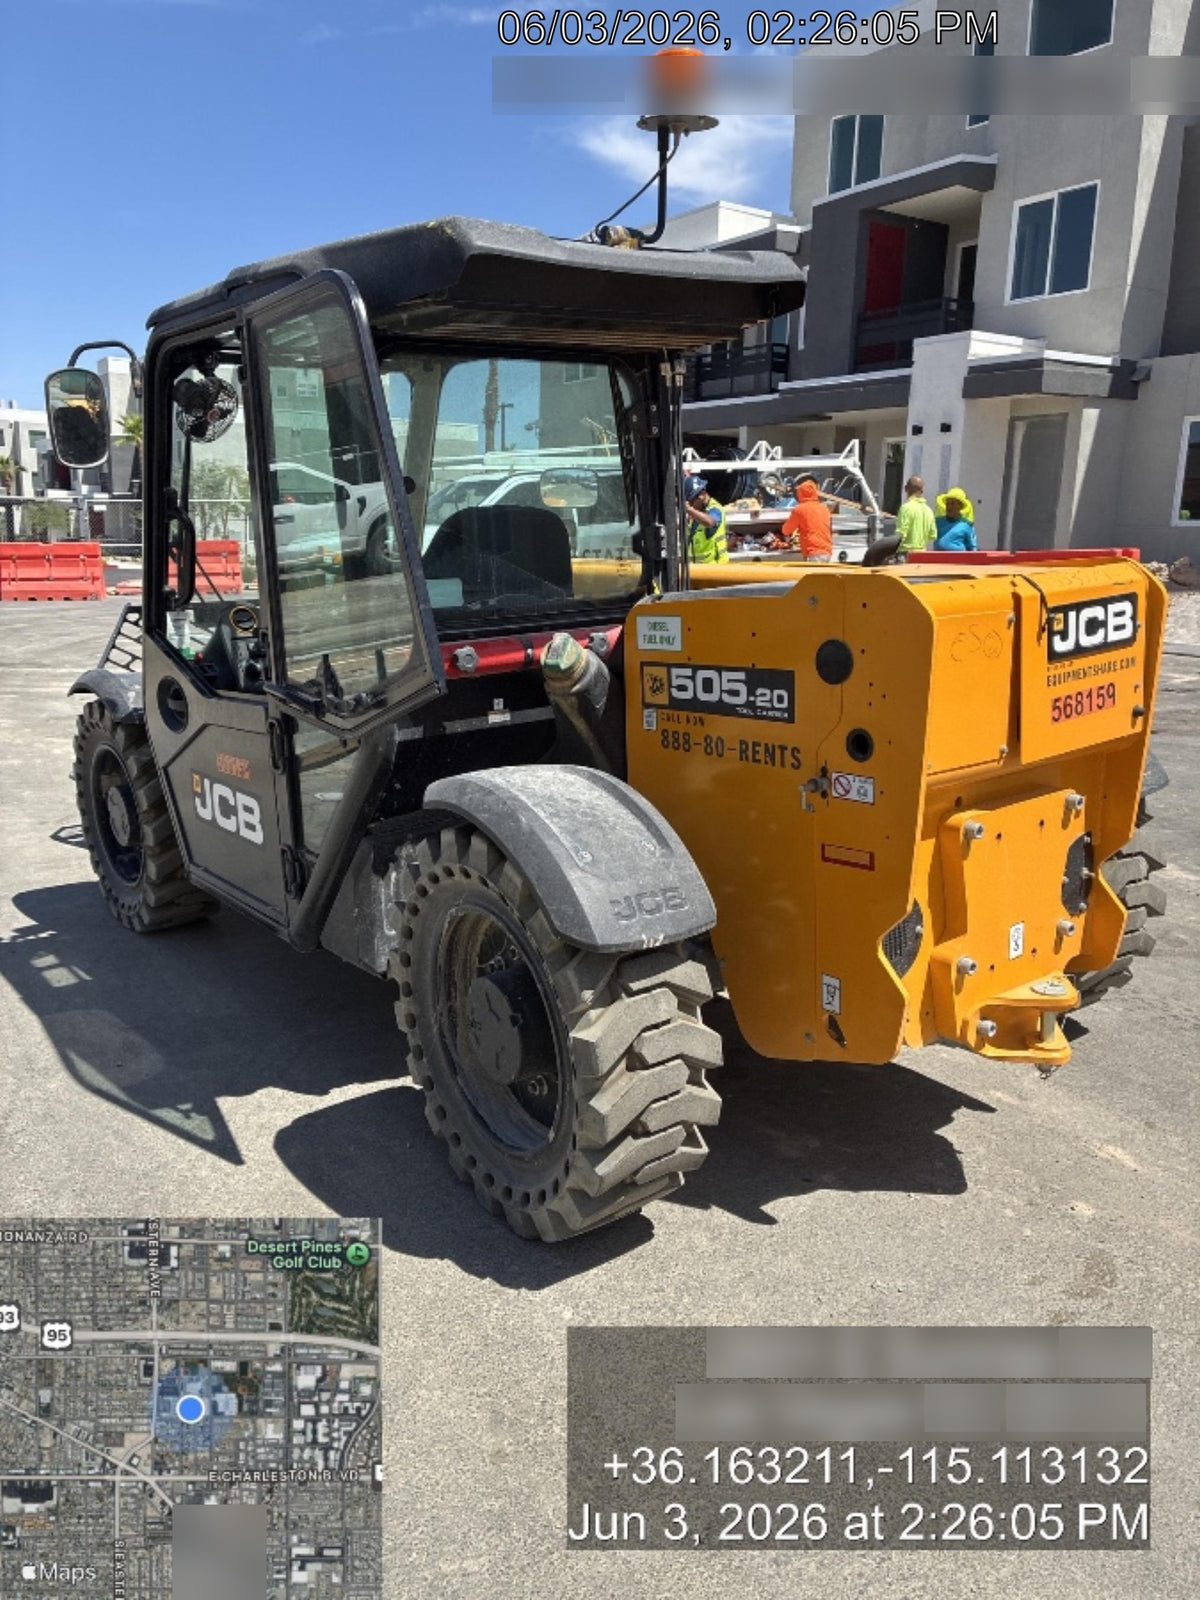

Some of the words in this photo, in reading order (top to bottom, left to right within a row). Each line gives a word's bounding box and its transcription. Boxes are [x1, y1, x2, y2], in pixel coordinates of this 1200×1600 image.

[1052, 600, 1134, 653] JCB
[1051, 682, 1116, 723] 568159
[660, 728, 802, 770] 888-80-RENTS
[194, 777, 264, 845] JCB
[609, 886, 688, 923] JCB
